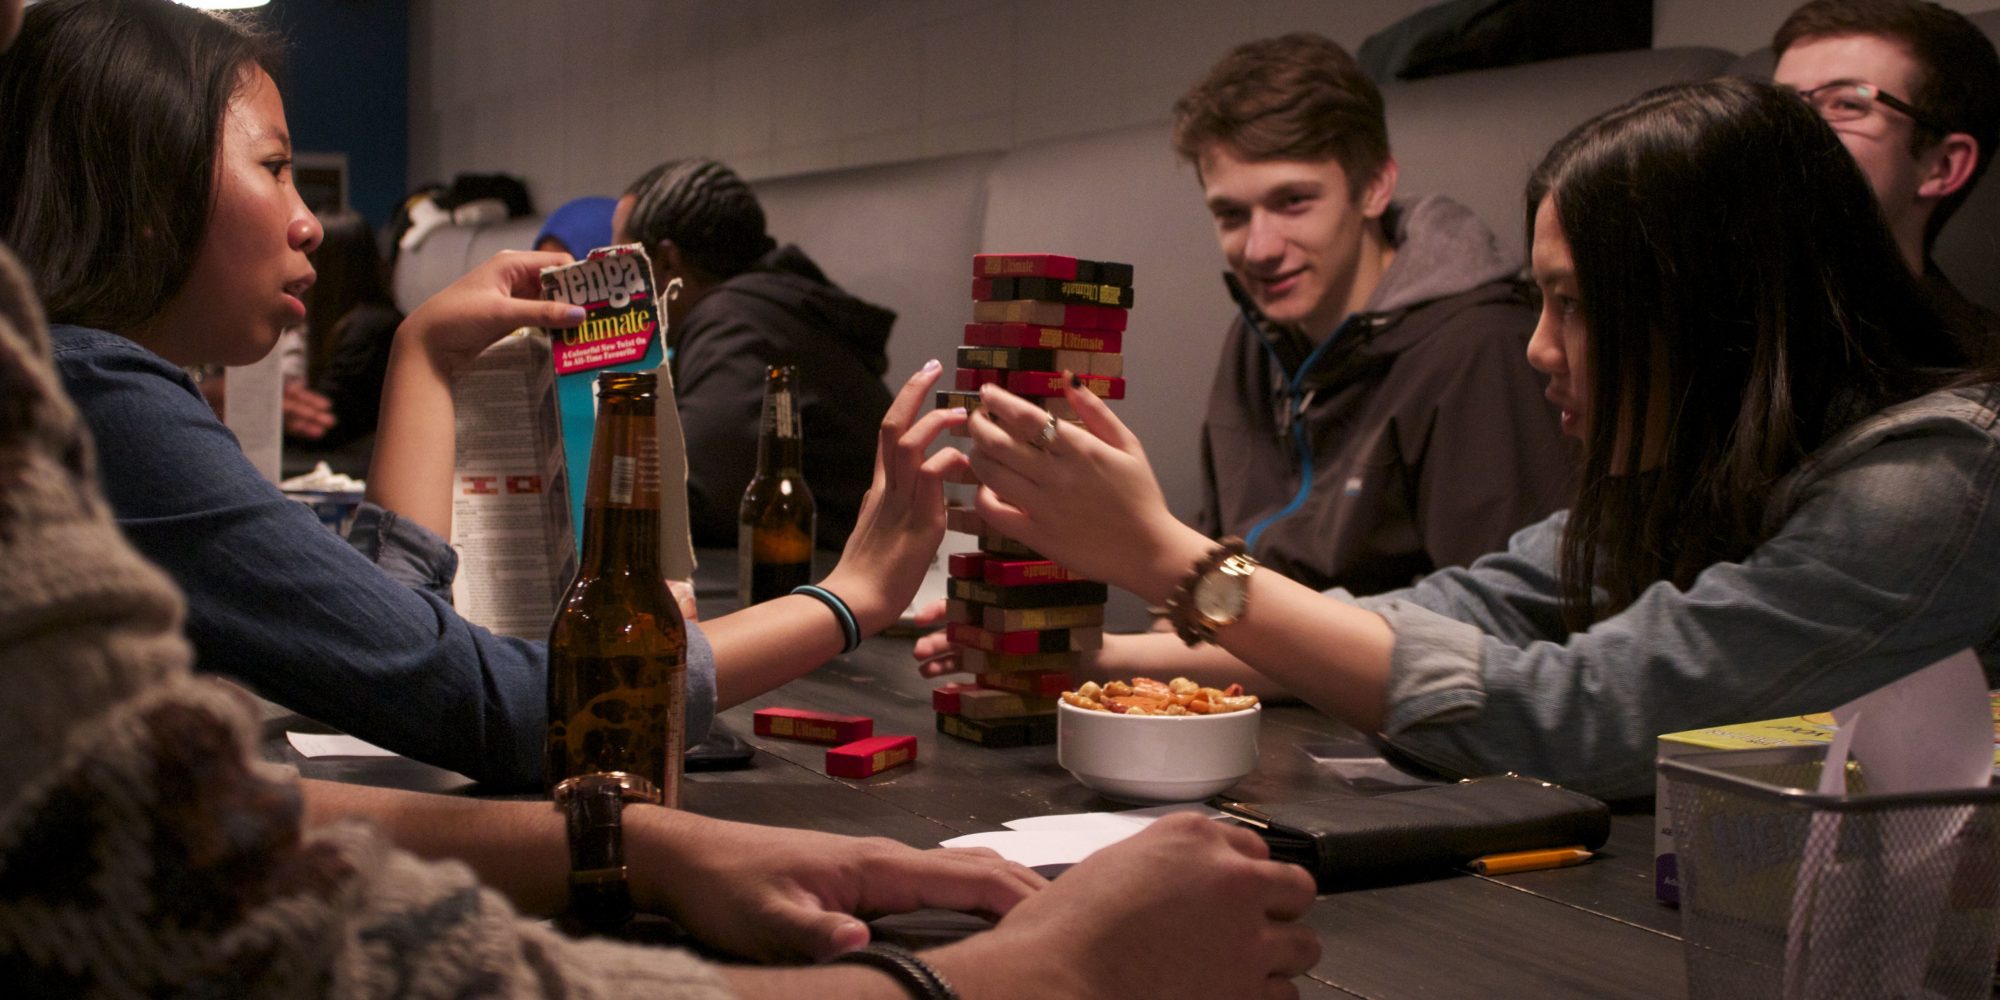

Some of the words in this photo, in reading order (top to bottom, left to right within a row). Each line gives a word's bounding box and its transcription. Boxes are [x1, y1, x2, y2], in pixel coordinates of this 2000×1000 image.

[552, 256, 647, 309] Jenga
[1061, 282, 1098, 301] Ultimate
[569, 344, 600, 358] Colourful
[601, 342, 615, 351] New
[616, 339, 635, 348] Twist
[1063, 332, 1104, 351] Ultimate
[563, 359, 573, 367] An
[574, 354, 603, 366] All-Time
[605, 348, 636, 360] Favourite
